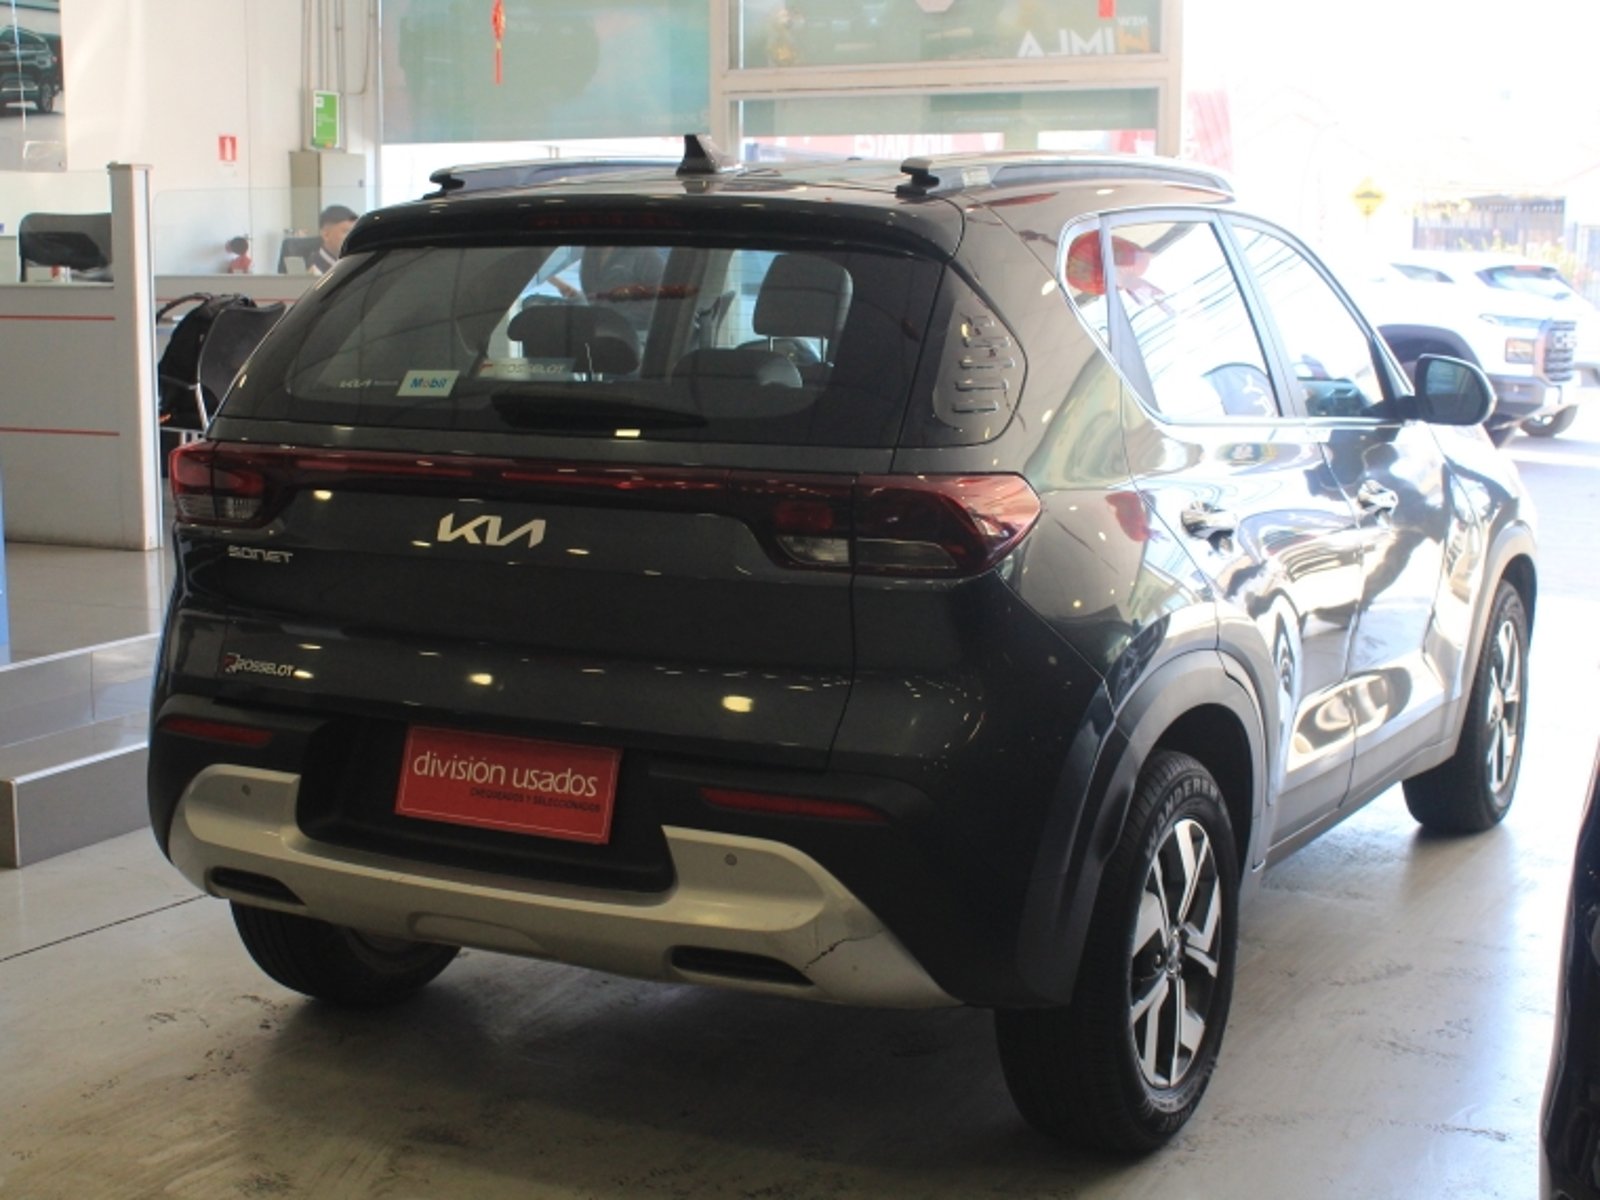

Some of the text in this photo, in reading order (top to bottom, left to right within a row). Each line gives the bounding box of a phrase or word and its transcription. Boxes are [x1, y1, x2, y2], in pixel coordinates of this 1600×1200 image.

[410, 377, 448, 389] Mobil
[437, 513, 547, 549] KIA
[228, 545, 294, 563] SONET
[413, 751, 598, 797] división usados
